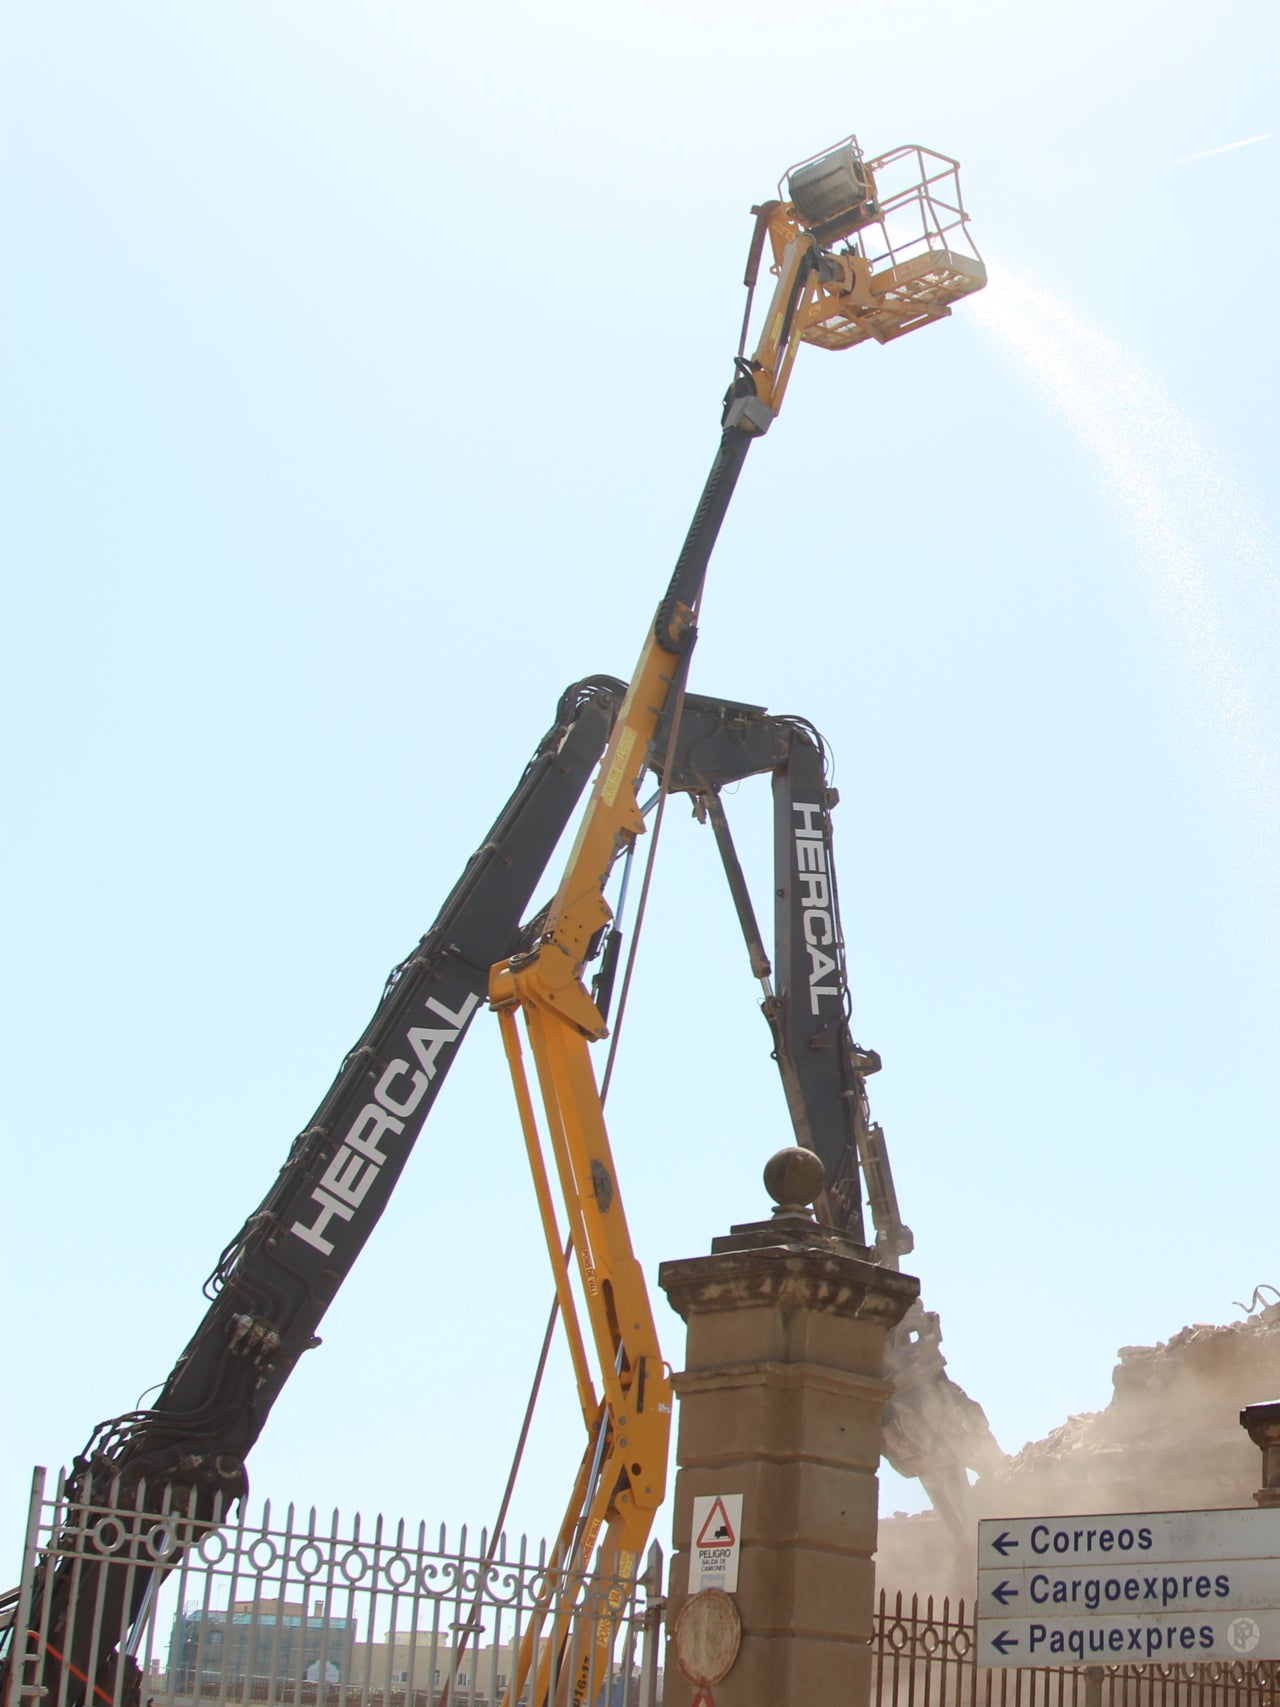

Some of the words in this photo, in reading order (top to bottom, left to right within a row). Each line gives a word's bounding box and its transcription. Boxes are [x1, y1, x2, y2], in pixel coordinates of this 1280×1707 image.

[792, 801, 840, 1016] HERCAL
[290, 991, 480, 1257] HERCAL
[699, 1549, 731, 1559] PELIGRO
[1030, 1525, 1153, 1554] Correos
[1030, 1574, 1230, 1609] Cargoexpres
[1029, 1624, 1215, 1660] Paquexpres
